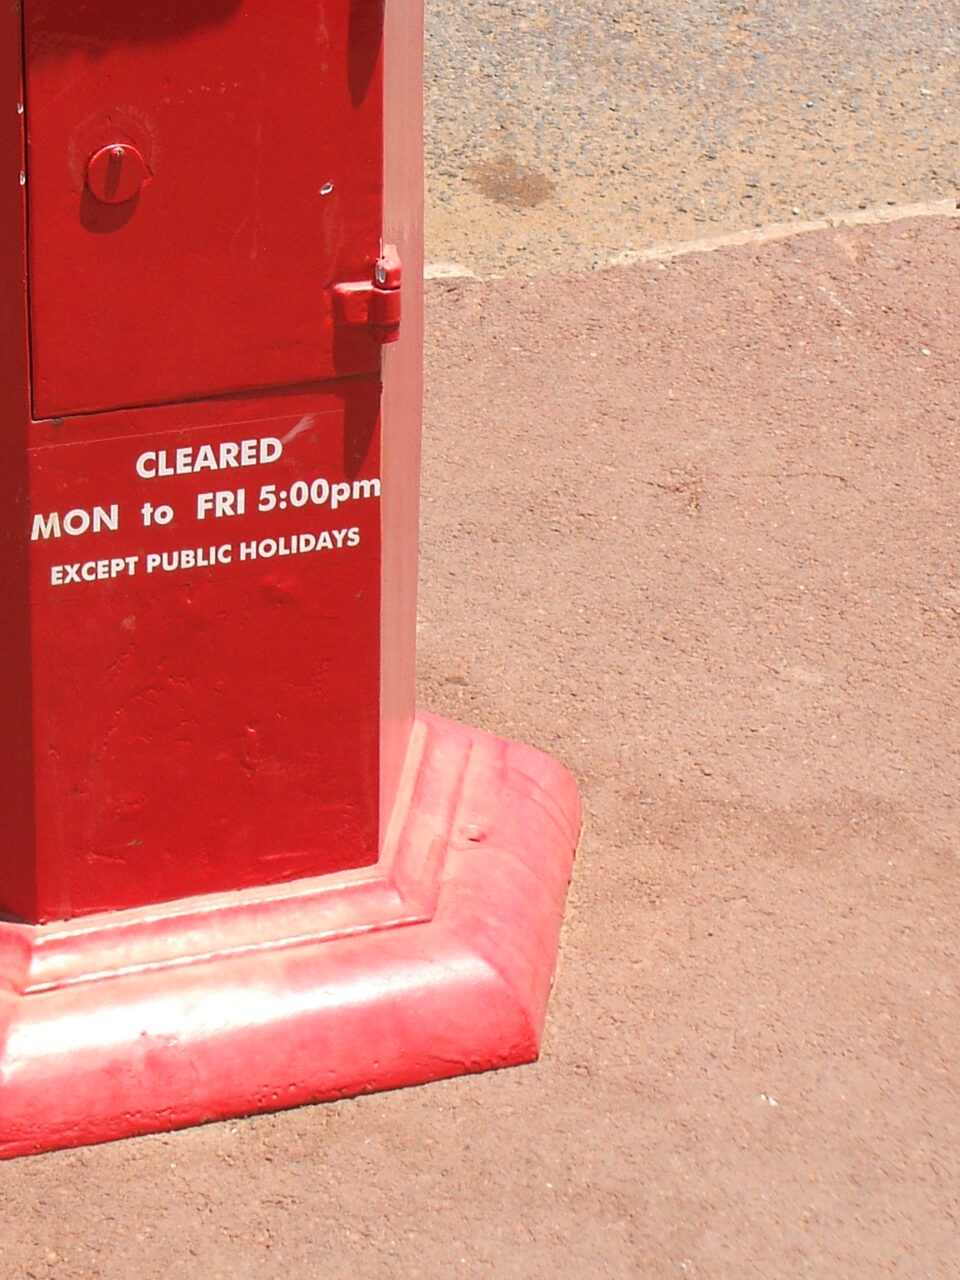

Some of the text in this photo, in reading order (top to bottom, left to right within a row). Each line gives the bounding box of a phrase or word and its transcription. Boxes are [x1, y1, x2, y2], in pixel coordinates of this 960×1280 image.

[135, 436, 284, 479] CLEARED
[30, 478, 382, 541] MON to FRI 5:00pm
[51, 527, 360, 586] EXCEPT PUBLIC HOLIDAYS
